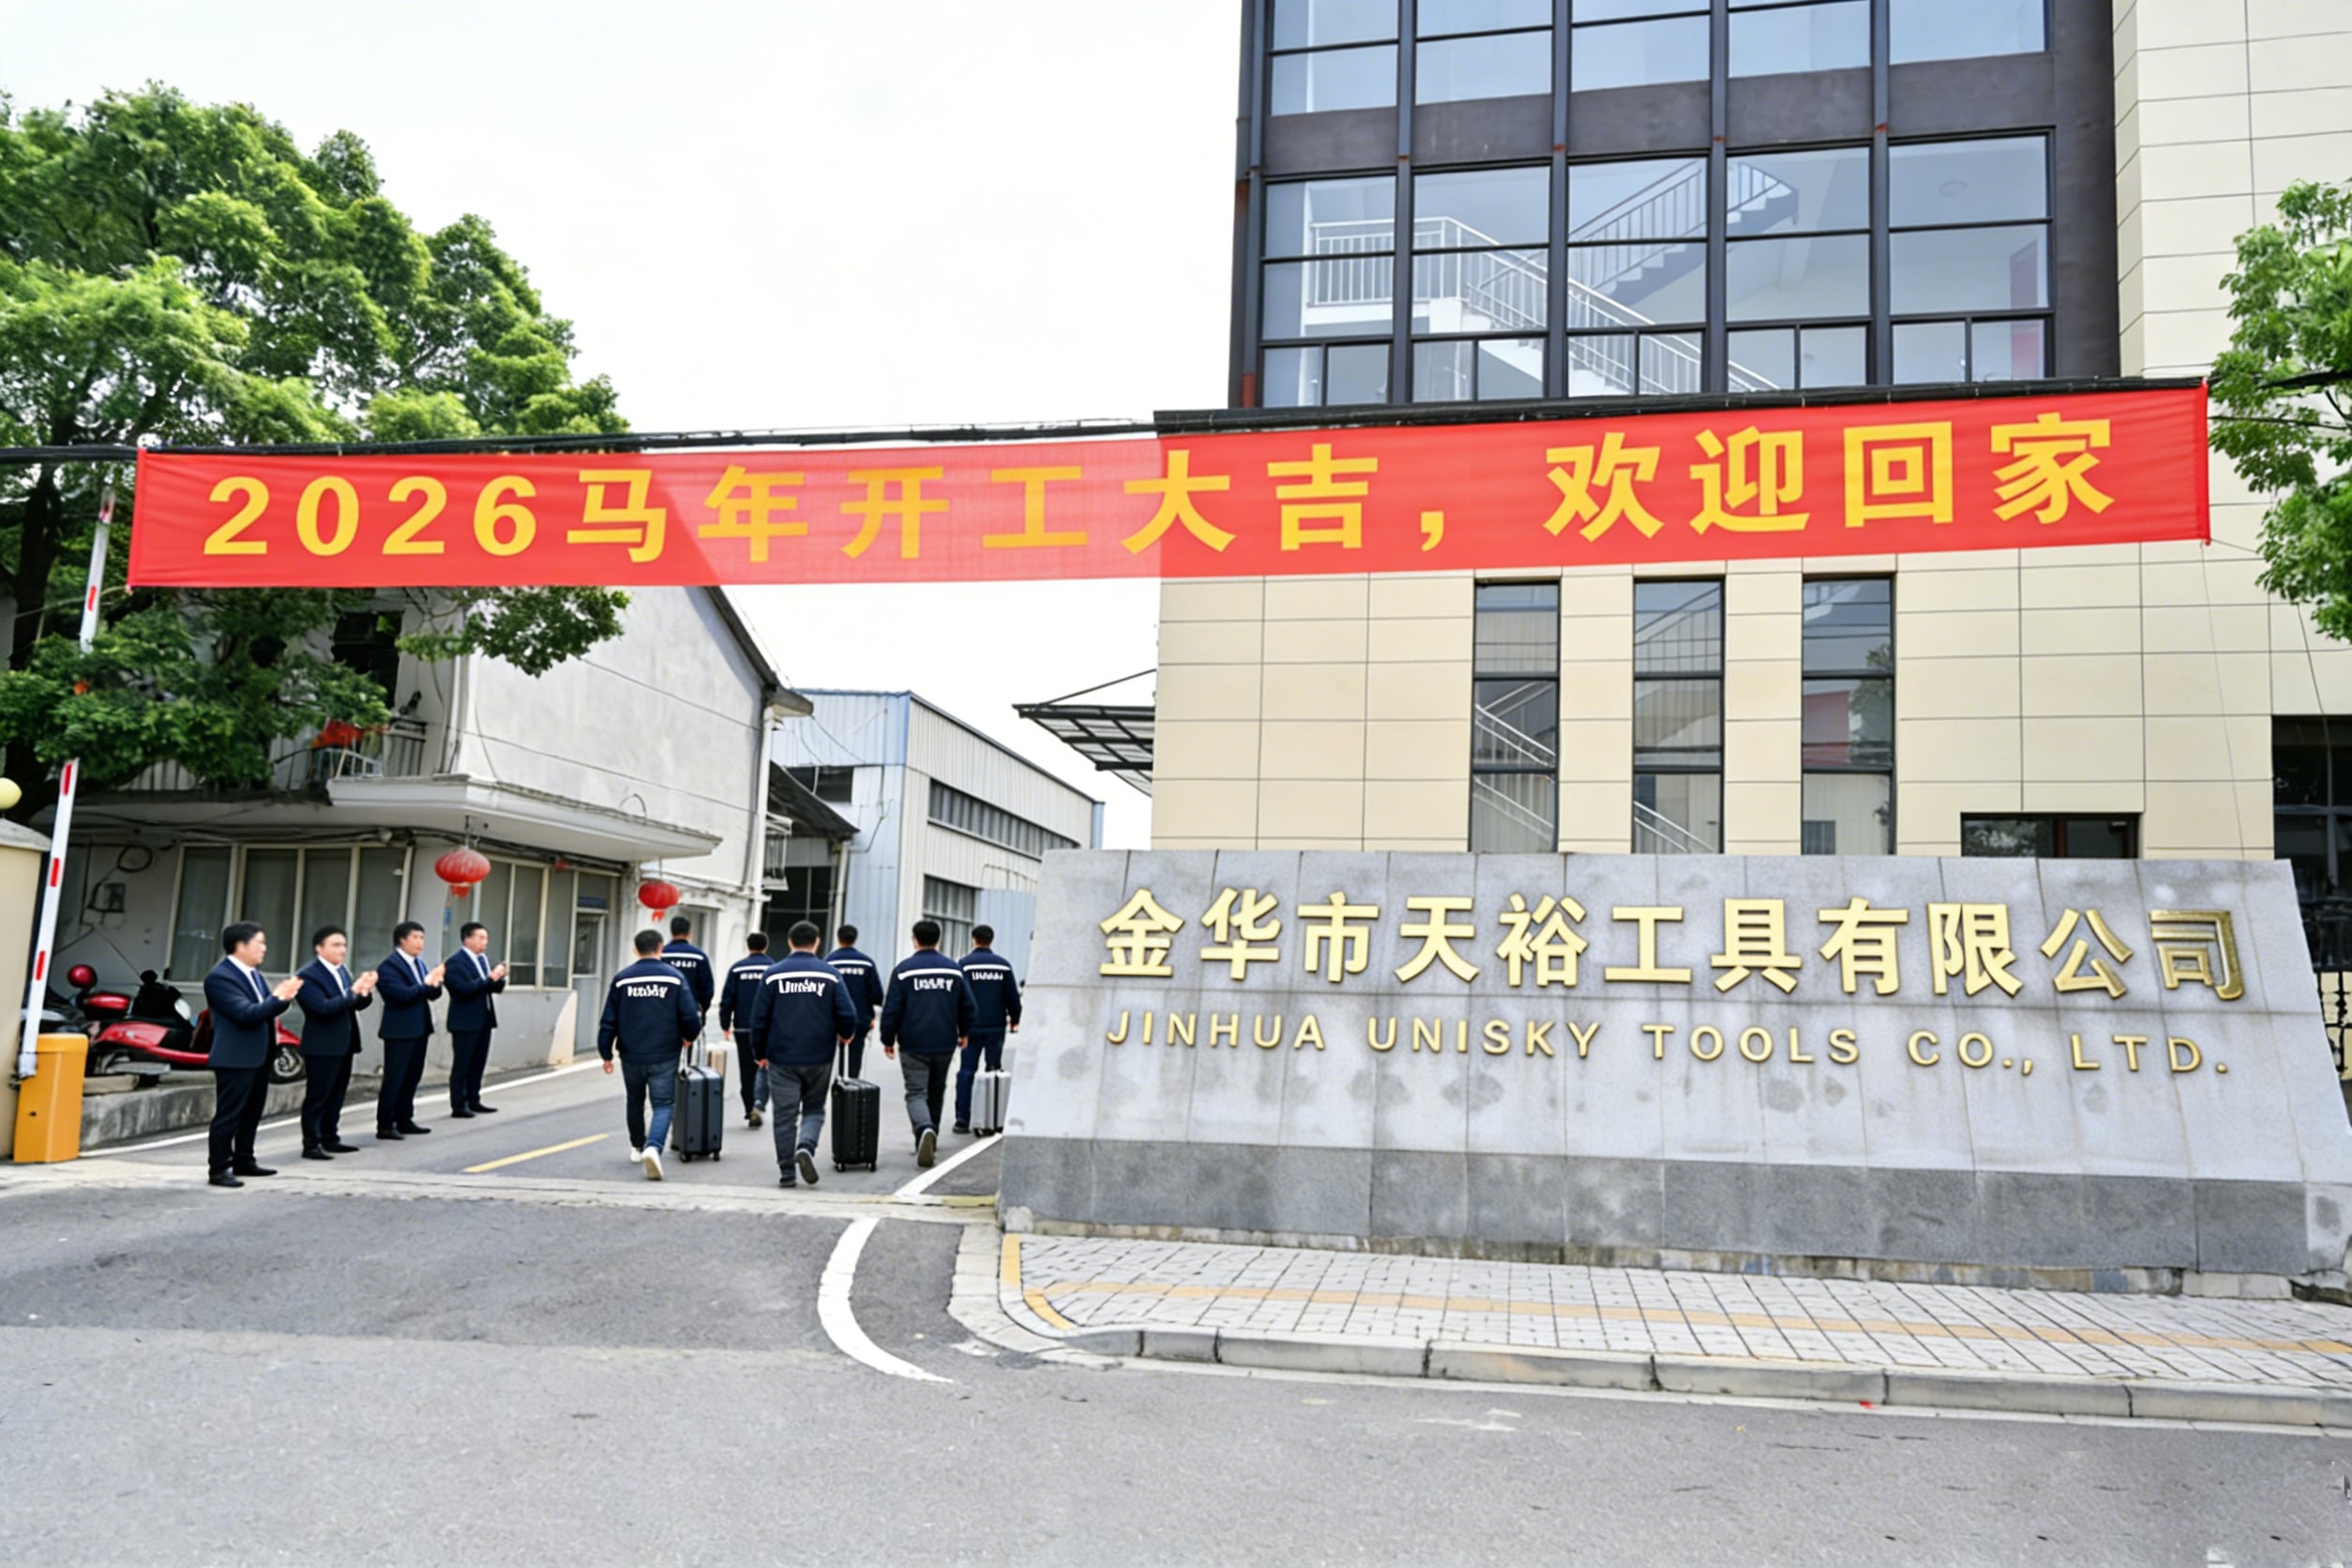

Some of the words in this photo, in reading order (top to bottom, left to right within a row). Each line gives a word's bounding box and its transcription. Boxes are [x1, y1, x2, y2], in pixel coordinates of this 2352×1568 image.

[1099, 887, 2245, 1001] 金华市天裕工具有限公司
[1106, 1010, 1326, 1051] JINHUA
[1366, 1016, 1601, 1059] UNISKY
[1642, 1023, 1861, 1064] TOOLS
[1907, 1031, 2034, 1075] CO.,
[2070, 1033, 2229, 1074] LTD.
